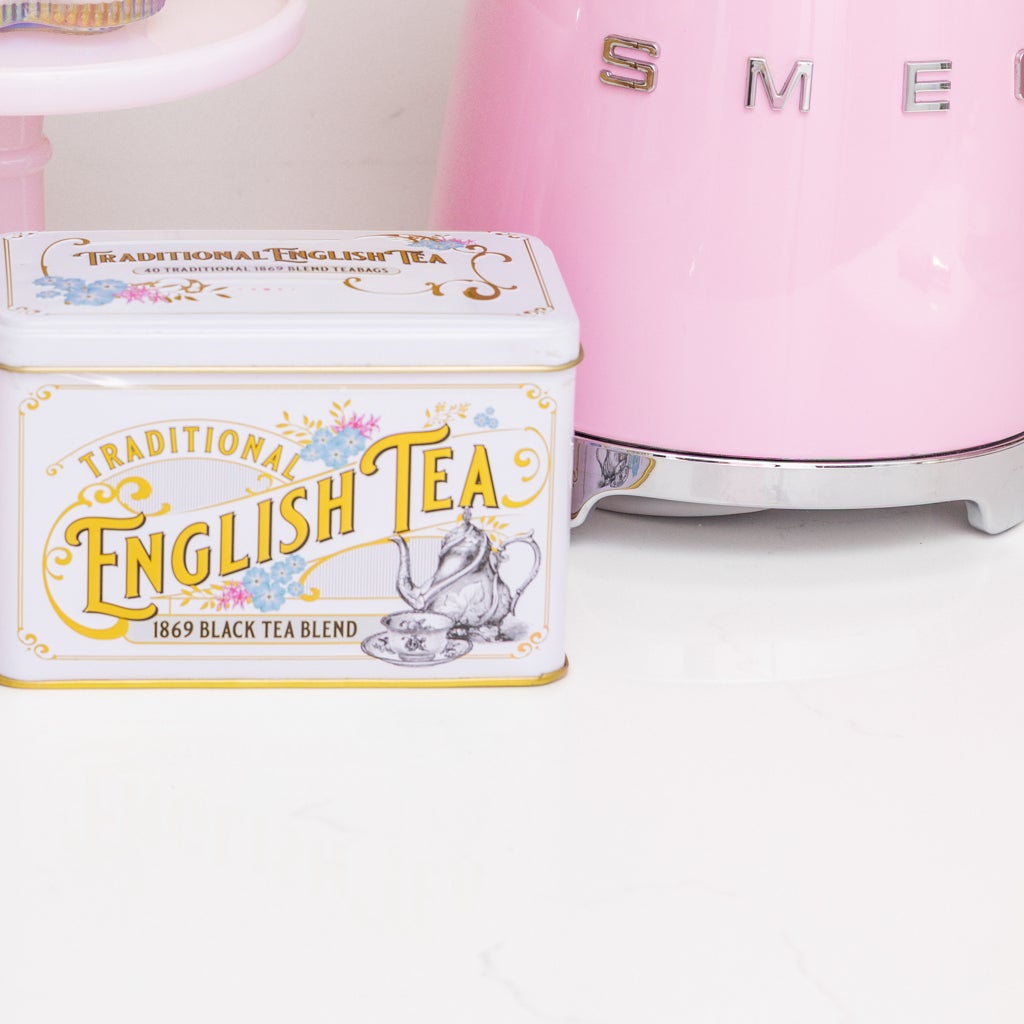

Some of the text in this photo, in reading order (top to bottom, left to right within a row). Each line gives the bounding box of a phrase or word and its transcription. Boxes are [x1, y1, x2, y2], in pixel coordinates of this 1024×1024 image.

[599, 33, 1024, 113] SME
[73, 247, 447, 266] TRADITIONAL ENGLISH TEA
[164, 265, 249, 274] TRADITIONAL
[254, 265, 284, 273] 1869
[287, 265, 329, 273] BLEND
[332, 266, 390, 274] TEABAGS
[78, 425, 303, 481] TRADITIONAL
[64, 423, 500, 621] ENGLISH TEA
[153, 620, 358, 639] 1869 BLACK TEA BLEND
